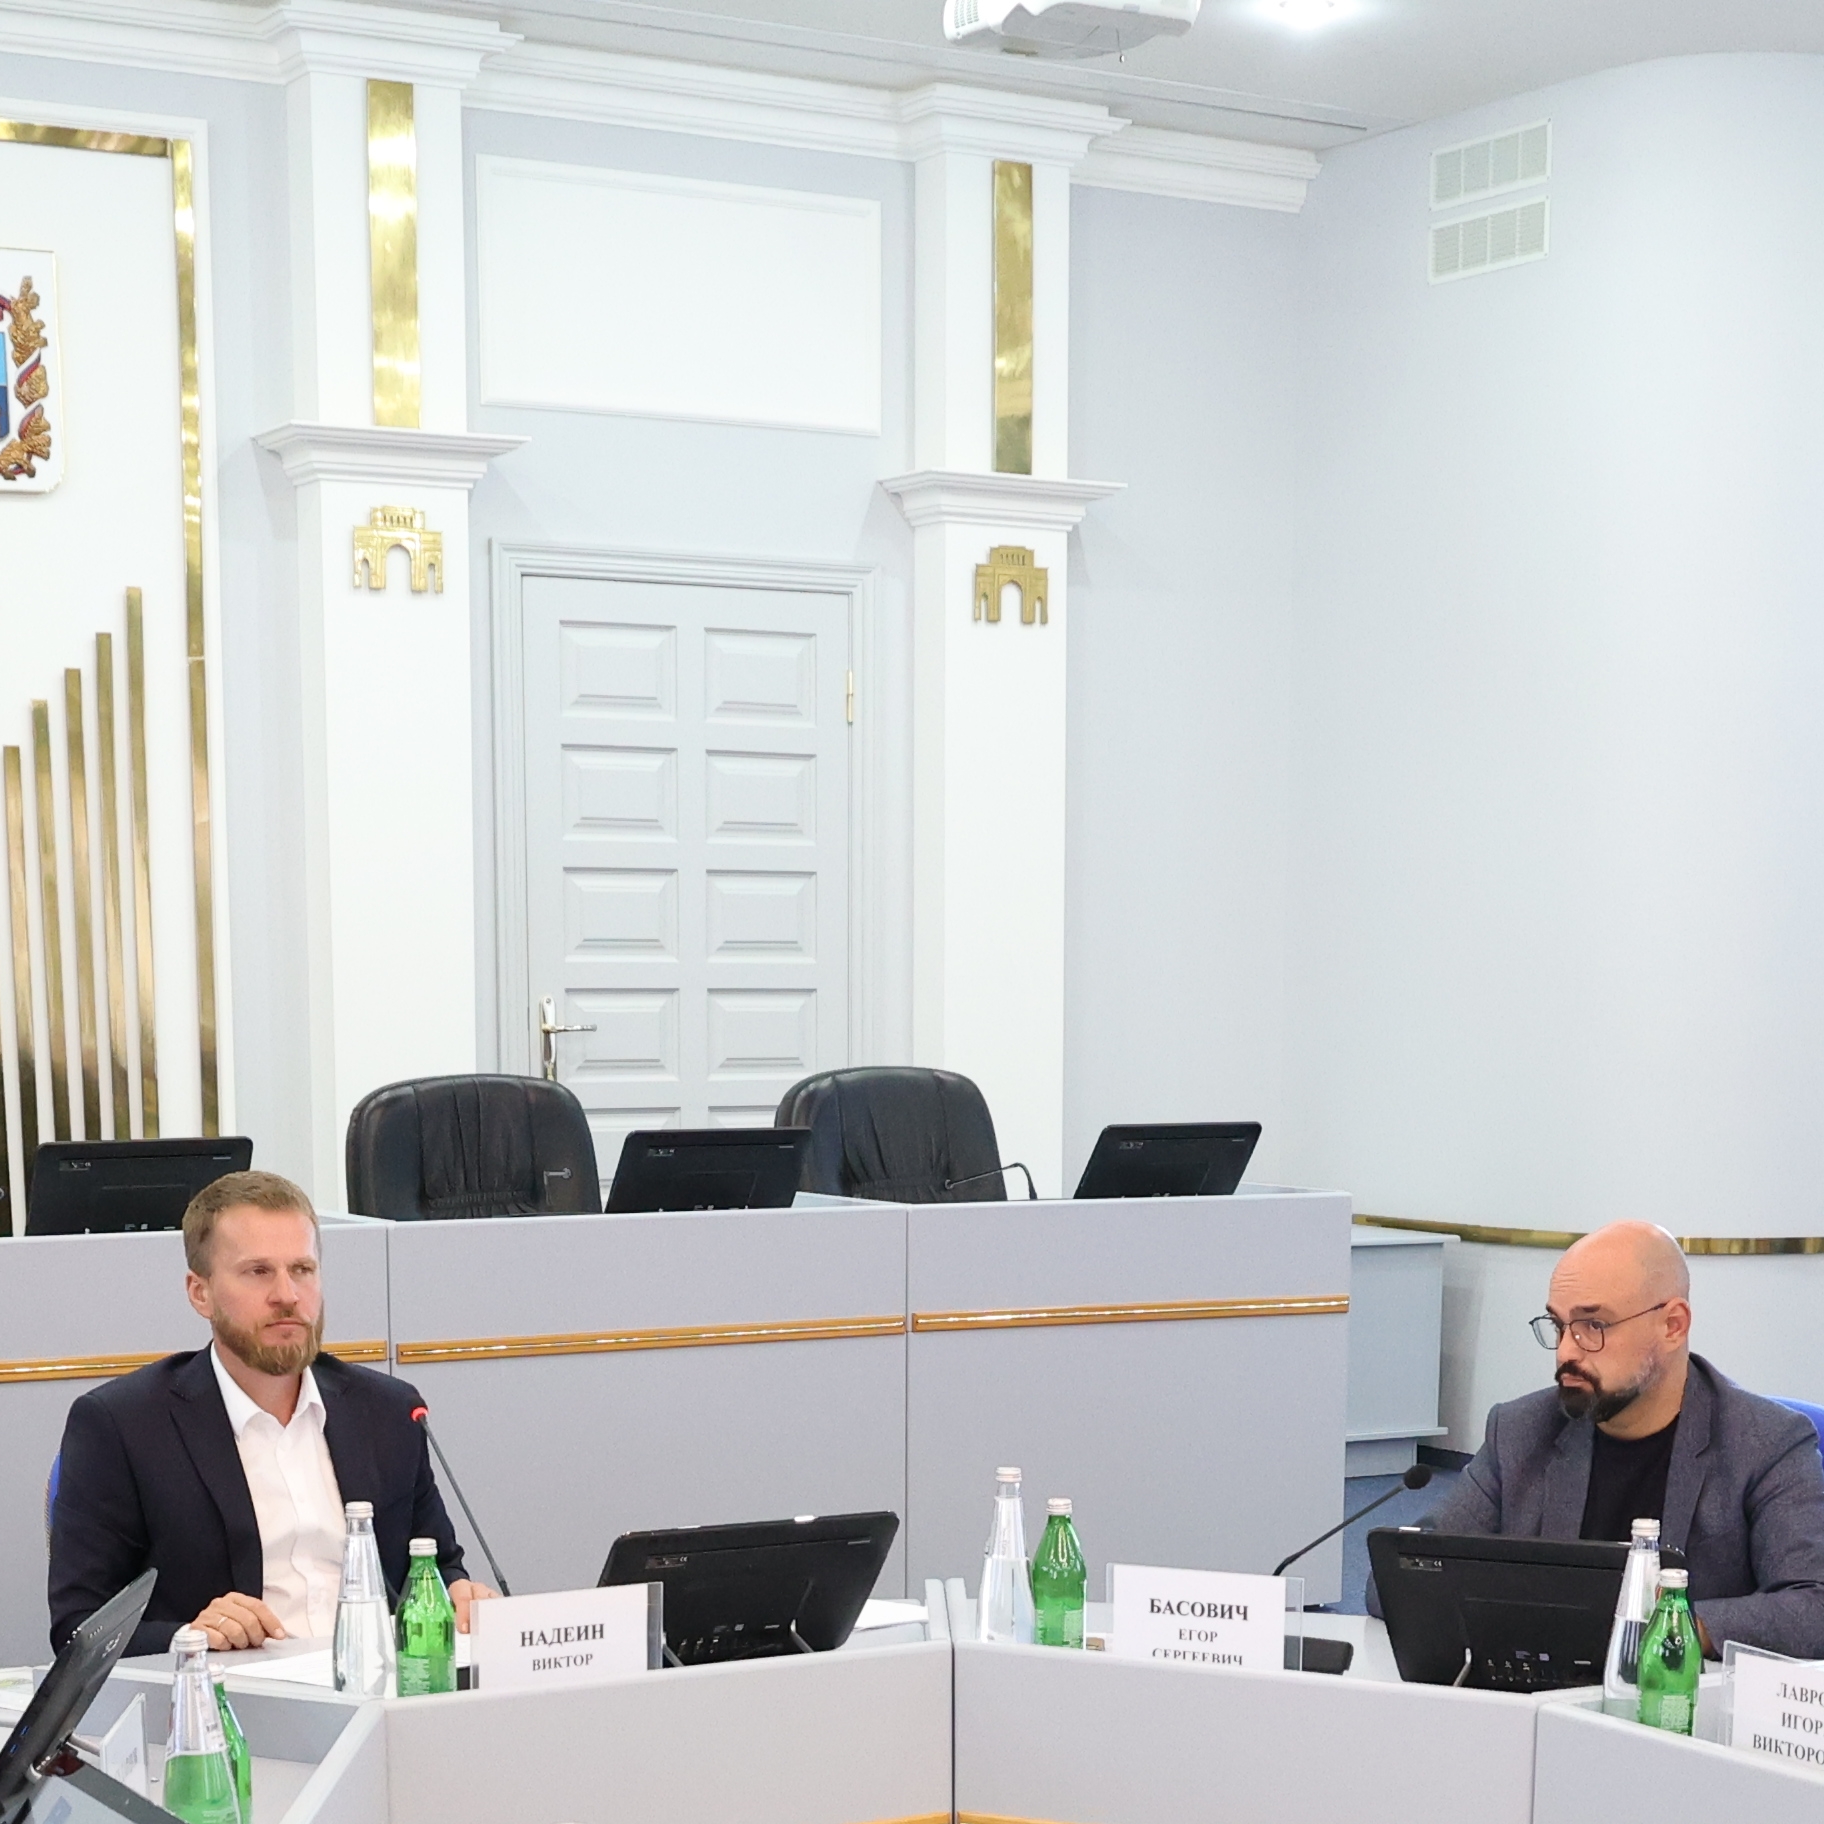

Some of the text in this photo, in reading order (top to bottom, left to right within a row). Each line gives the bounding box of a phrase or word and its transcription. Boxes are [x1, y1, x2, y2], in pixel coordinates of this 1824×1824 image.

[1149, 1598, 1249, 1621] БАСОВИЧ
[520, 1623, 605, 1647] НАДЕИН
[1178, 1628, 1218, 1643] ЕГОР
[532, 1653, 594, 1671] ВИКТОР
